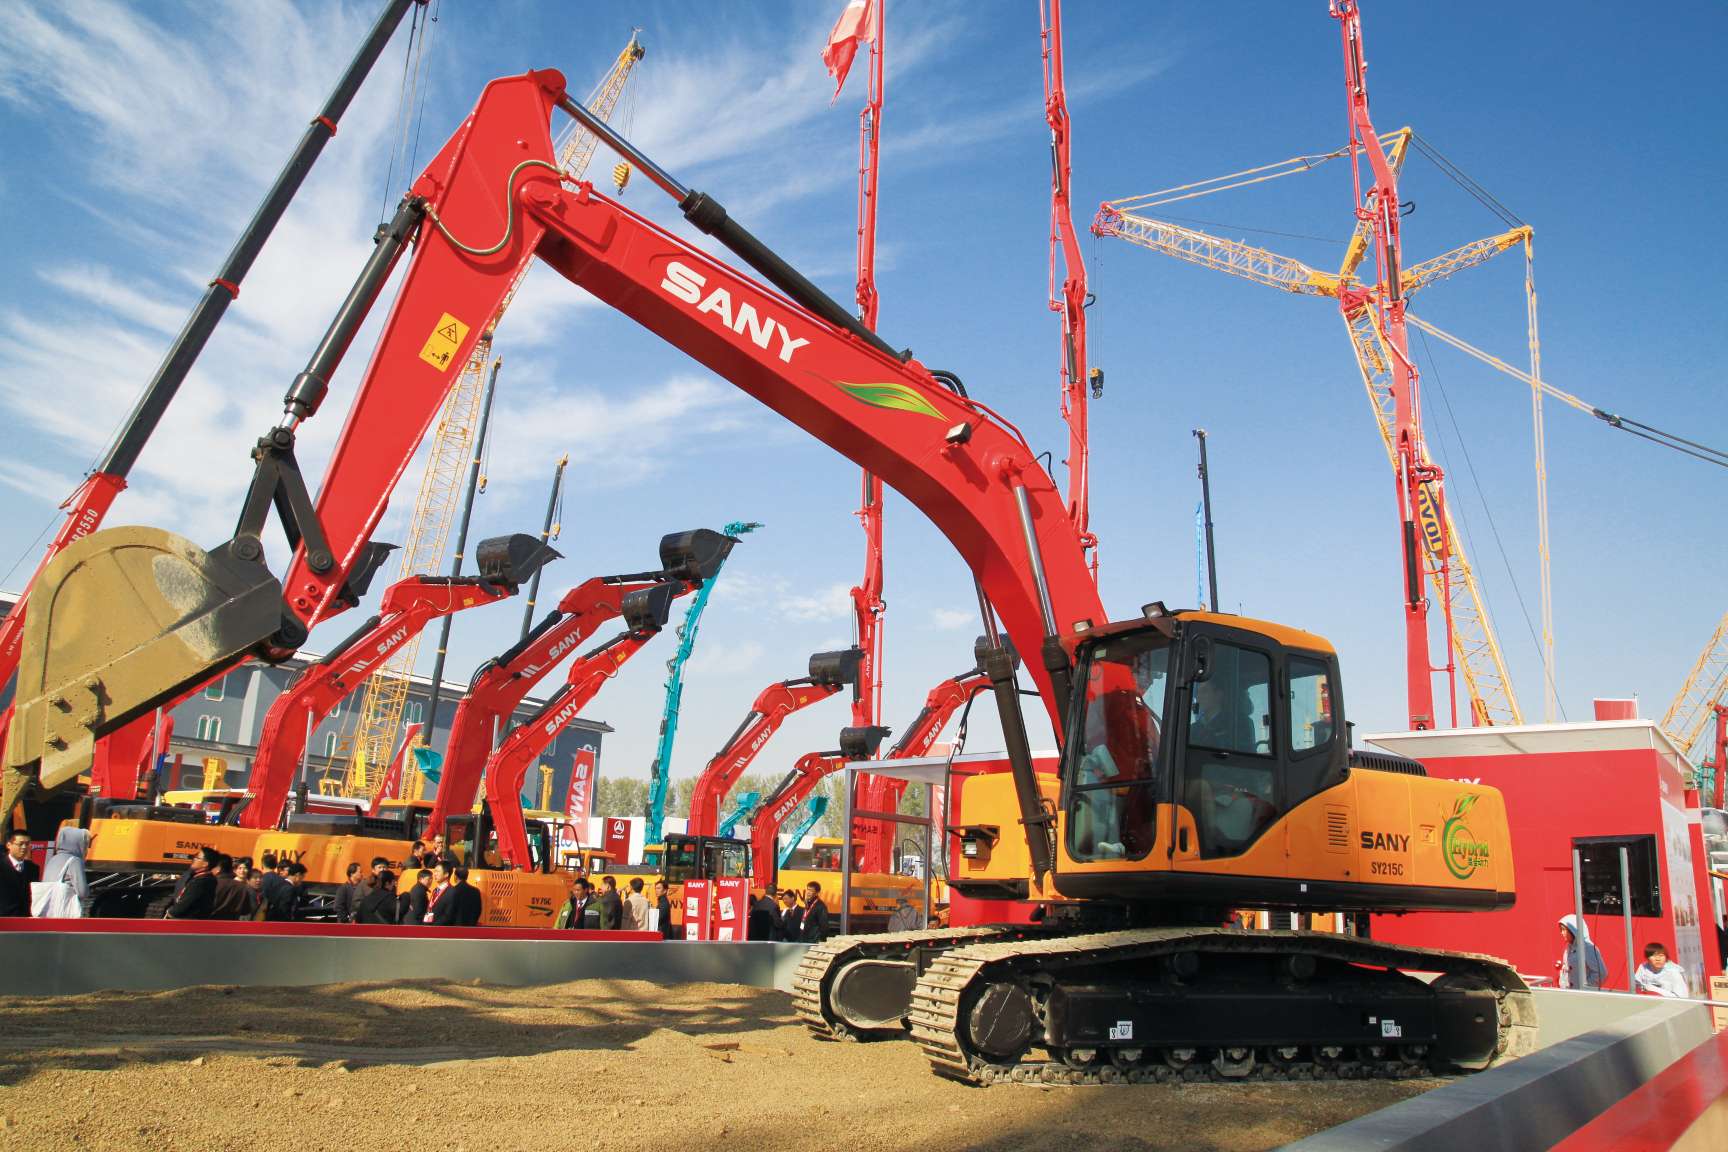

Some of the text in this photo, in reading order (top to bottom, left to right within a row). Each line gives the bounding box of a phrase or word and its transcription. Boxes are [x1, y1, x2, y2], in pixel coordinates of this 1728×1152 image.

[660, 261, 811, 364] SANY
[69, 508, 98, 545] RC550
[1419, 487, 1442, 548] OVOL
[376, 626, 408, 655] SANY
[549, 627, 581, 660] SANY
[545, 698, 578, 736] SANY
[750, 724, 771, 751] SANY
[923, 717, 943, 749] SANY
[773, 793, 798, 822] SANY
[1360, 831, 1410, 852] SANY
[1371, 861, 1404, 876] SY215C
[719, 880, 740, 888] SANY
